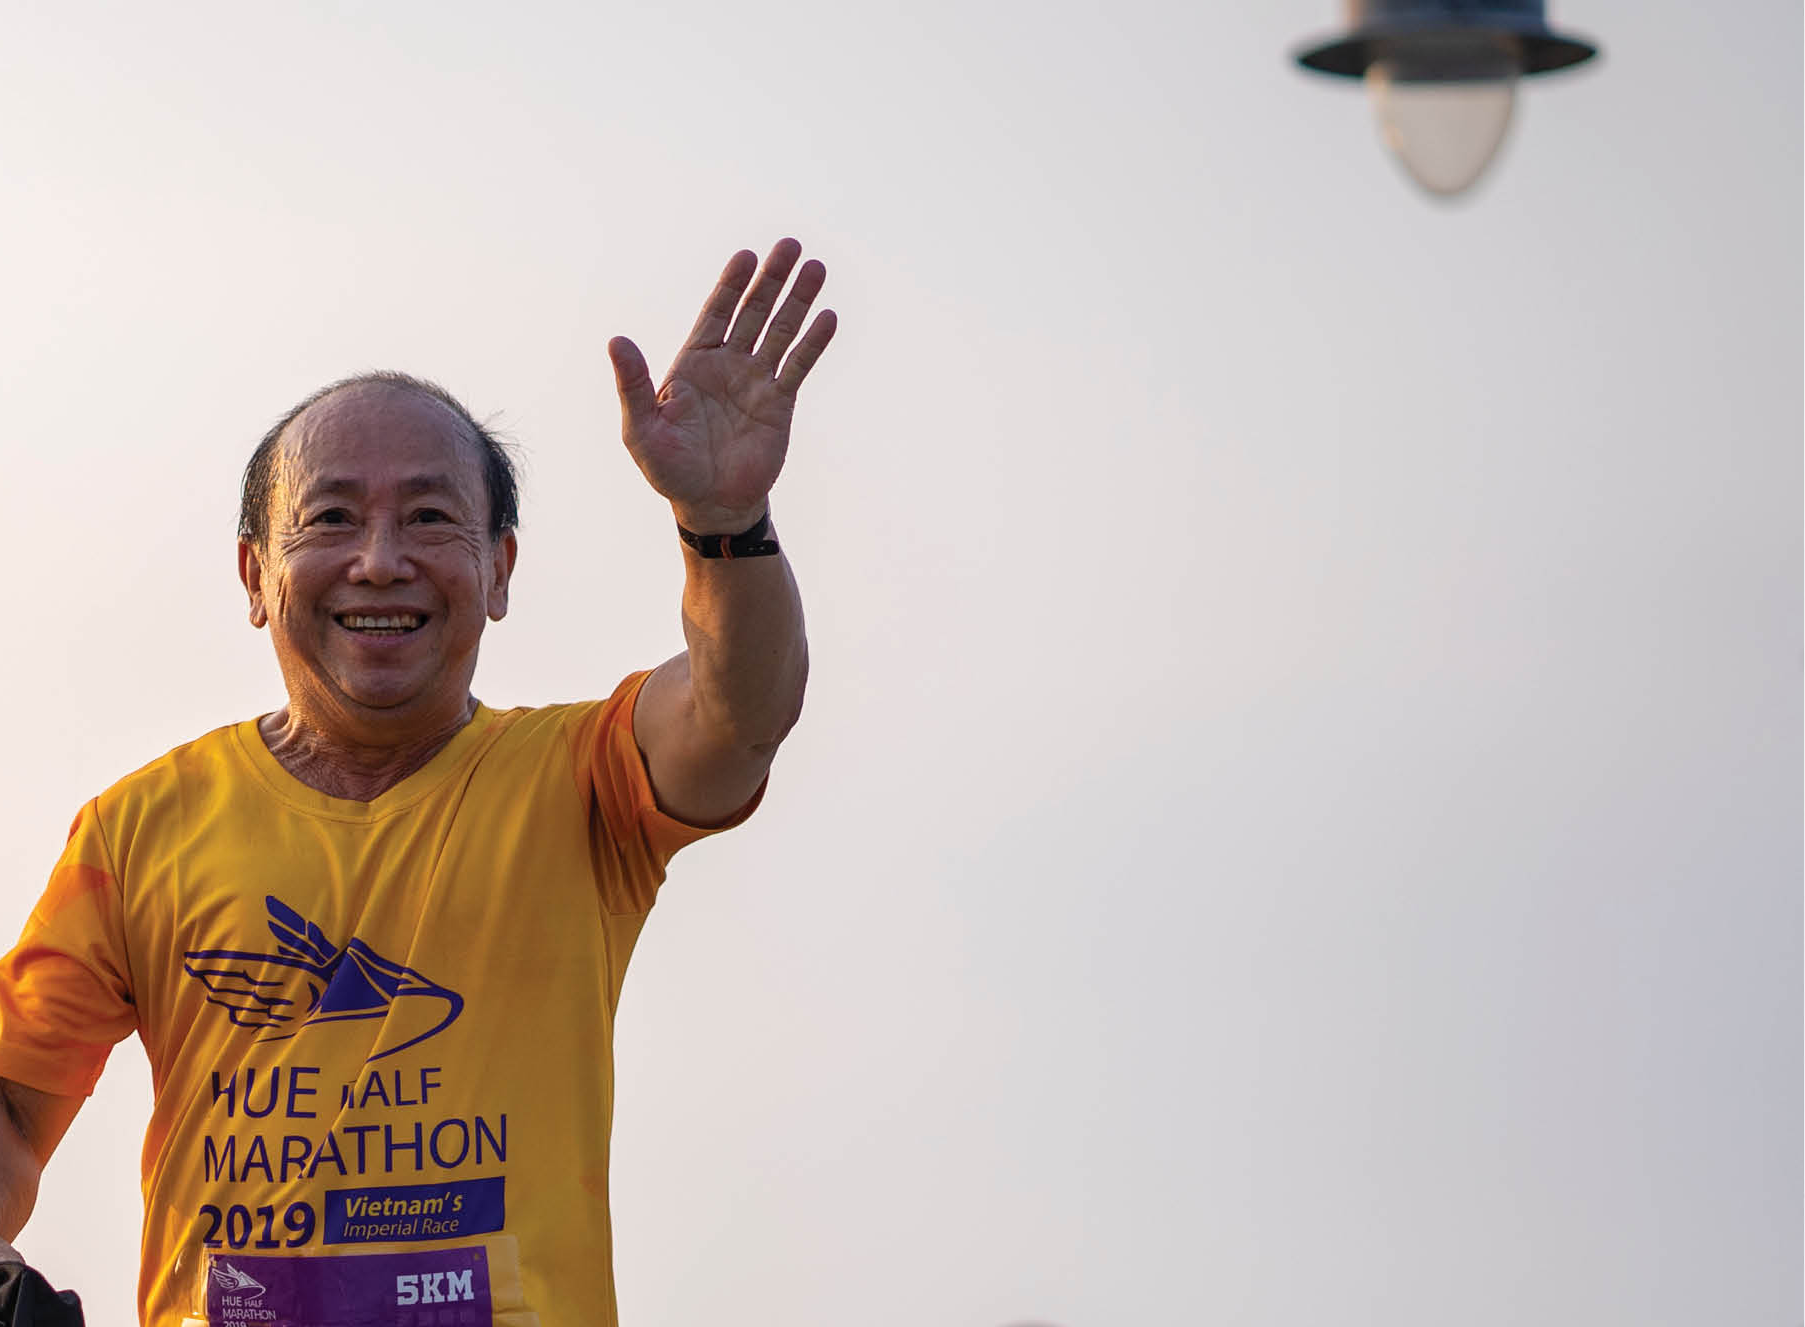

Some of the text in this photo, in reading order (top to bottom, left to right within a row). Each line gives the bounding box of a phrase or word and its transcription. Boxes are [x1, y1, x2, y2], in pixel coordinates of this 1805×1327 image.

[211, 1066, 321, 1119] HUE
[203, 1113, 507, 1183] MARATHON
[345, 1191, 463, 1218] Vietnam's
[198, 1201, 316, 1249] 2019
[343, 1218, 460, 1241] Imperial Race
[221, 1295, 263, 1308] HUE HALF
[396, 1269, 475, 1306] 5KM
[222, 1308, 277, 1320] MARATHON
